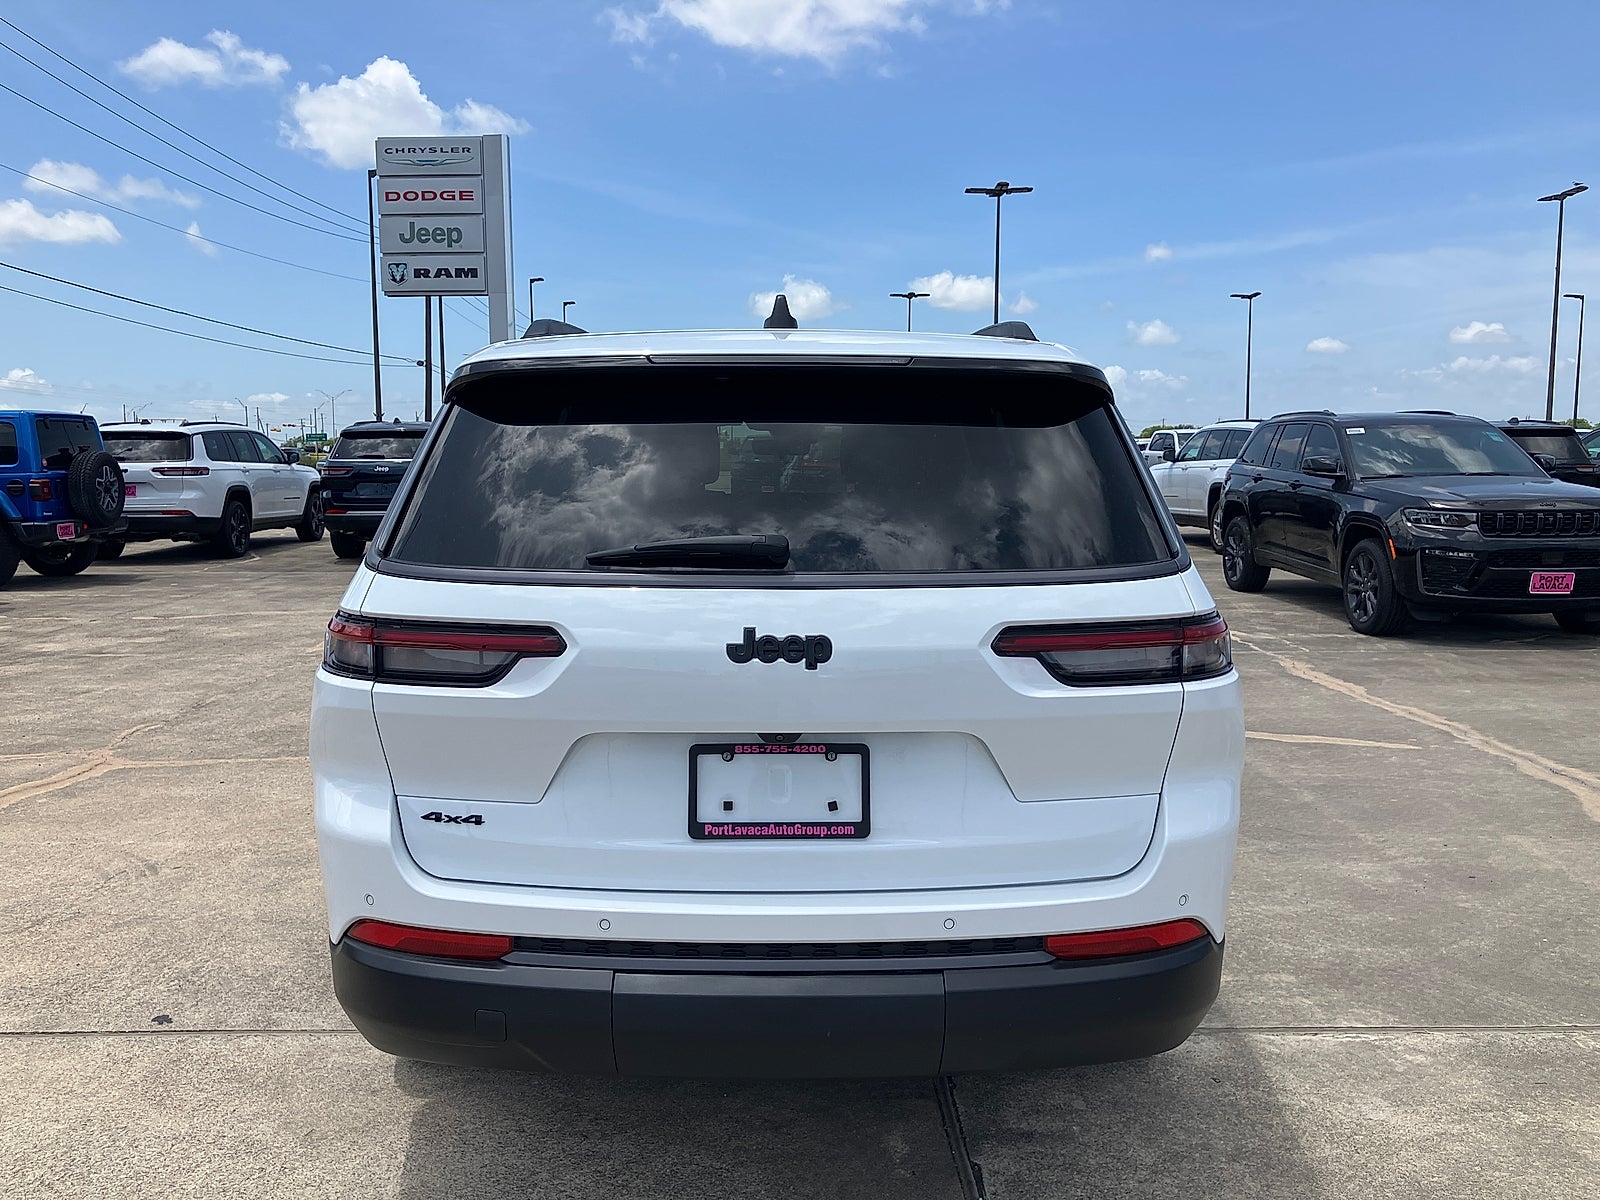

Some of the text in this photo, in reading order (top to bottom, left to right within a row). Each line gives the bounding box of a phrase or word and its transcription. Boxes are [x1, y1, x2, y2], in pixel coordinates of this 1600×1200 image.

[385, 191, 474, 201] DODGE
[399, 221, 463, 248] Jeep
[413, 268, 478, 278] RAM
[726, 626, 833, 670] Jeep
[734, 745, 826, 753] 855-755-4200
[420, 811, 486, 826] 4x4
[704, 824, 855, 837] PortLavacaAutoGroup.com
